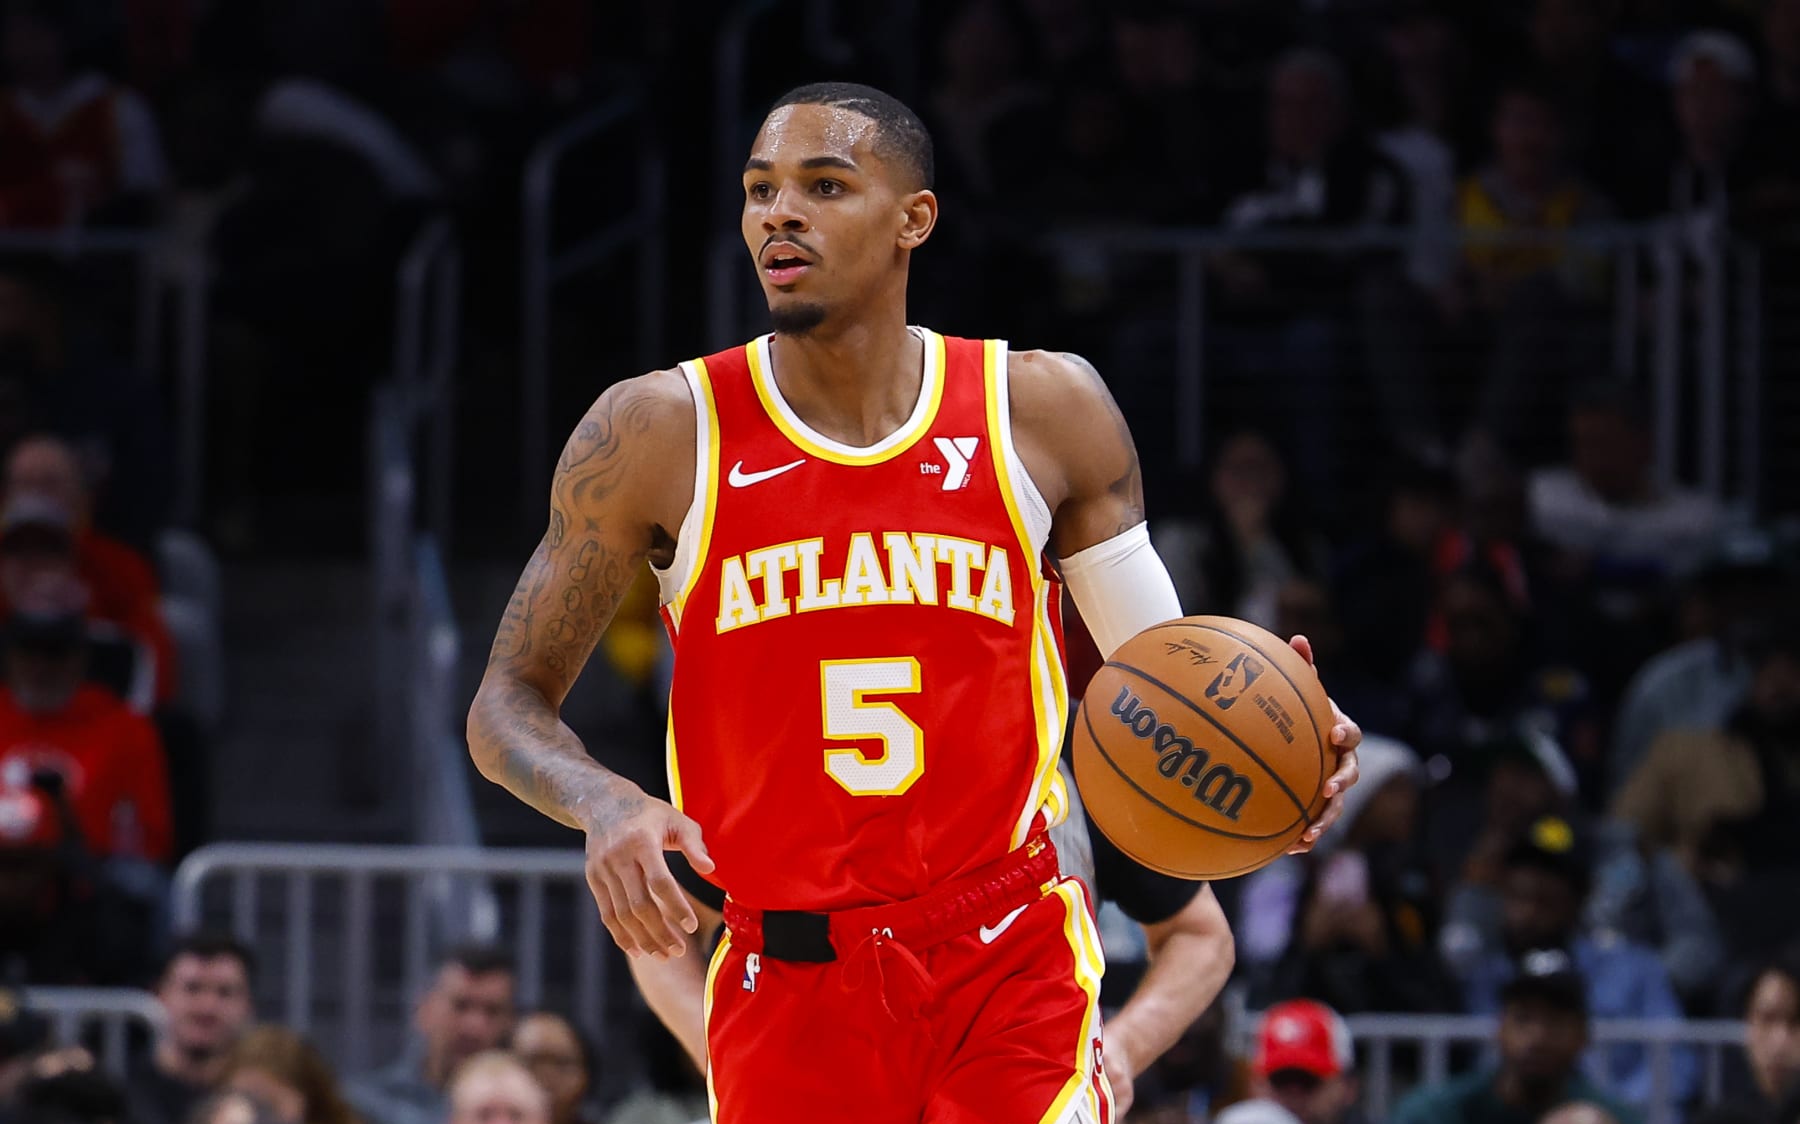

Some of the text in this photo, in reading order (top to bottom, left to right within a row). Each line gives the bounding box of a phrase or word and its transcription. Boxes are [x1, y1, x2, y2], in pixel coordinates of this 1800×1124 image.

[920, 436, 980, 491] the Y
[715, 531, 1016, 635] ATLANTA
[819, 656, 925, 797] 5
[1109, 684, 1255, 822] Wilson
